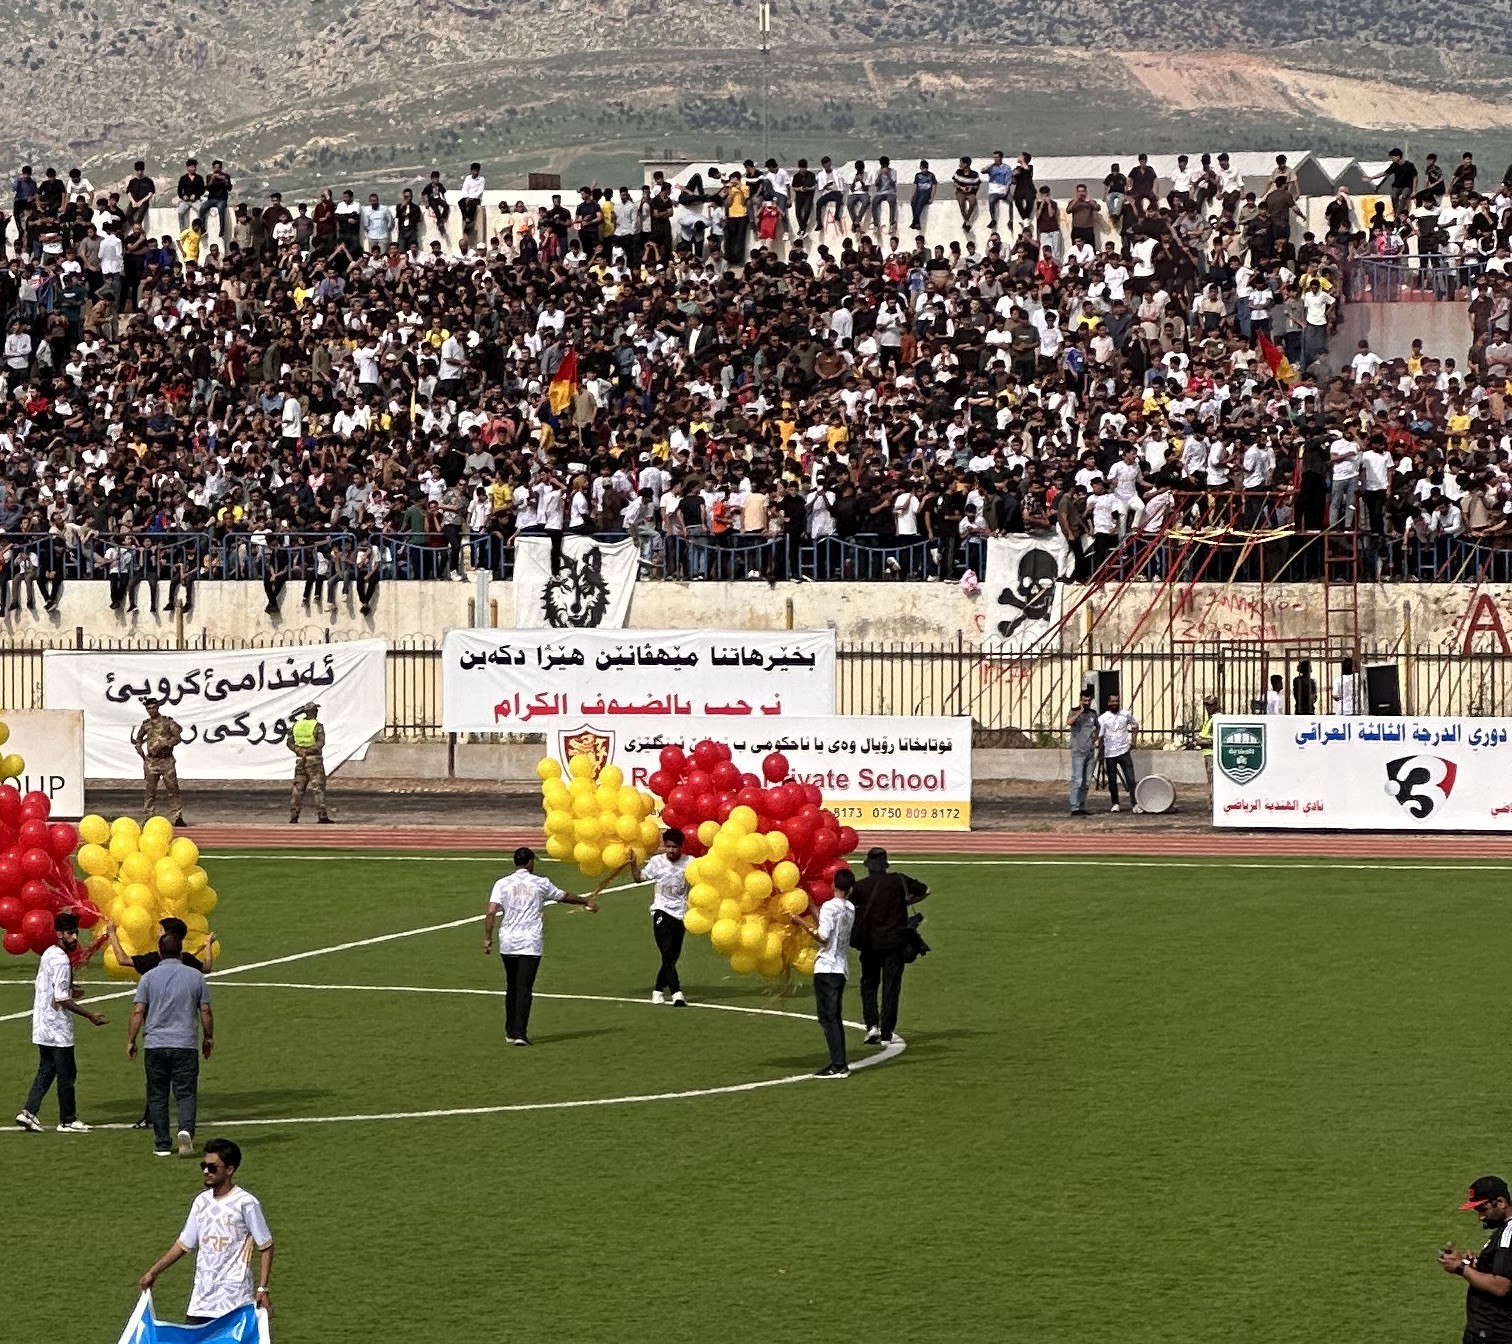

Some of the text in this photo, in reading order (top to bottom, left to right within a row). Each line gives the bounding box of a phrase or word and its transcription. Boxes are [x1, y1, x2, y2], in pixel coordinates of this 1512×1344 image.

[494, 691, 568, 725] الكرام
[1295, 722, 1507, 751] دوري الدرجة الثالثة العراقي
[858, 768, 947, 791] School
[872, 808, 902, 818] 0750
[905, 808, 927, 818] 809
[930, 808, 960, 819] 8172
[1223, 797, 1261, 816] الرياضي
[1303, 798, 1324, 816] نادي
